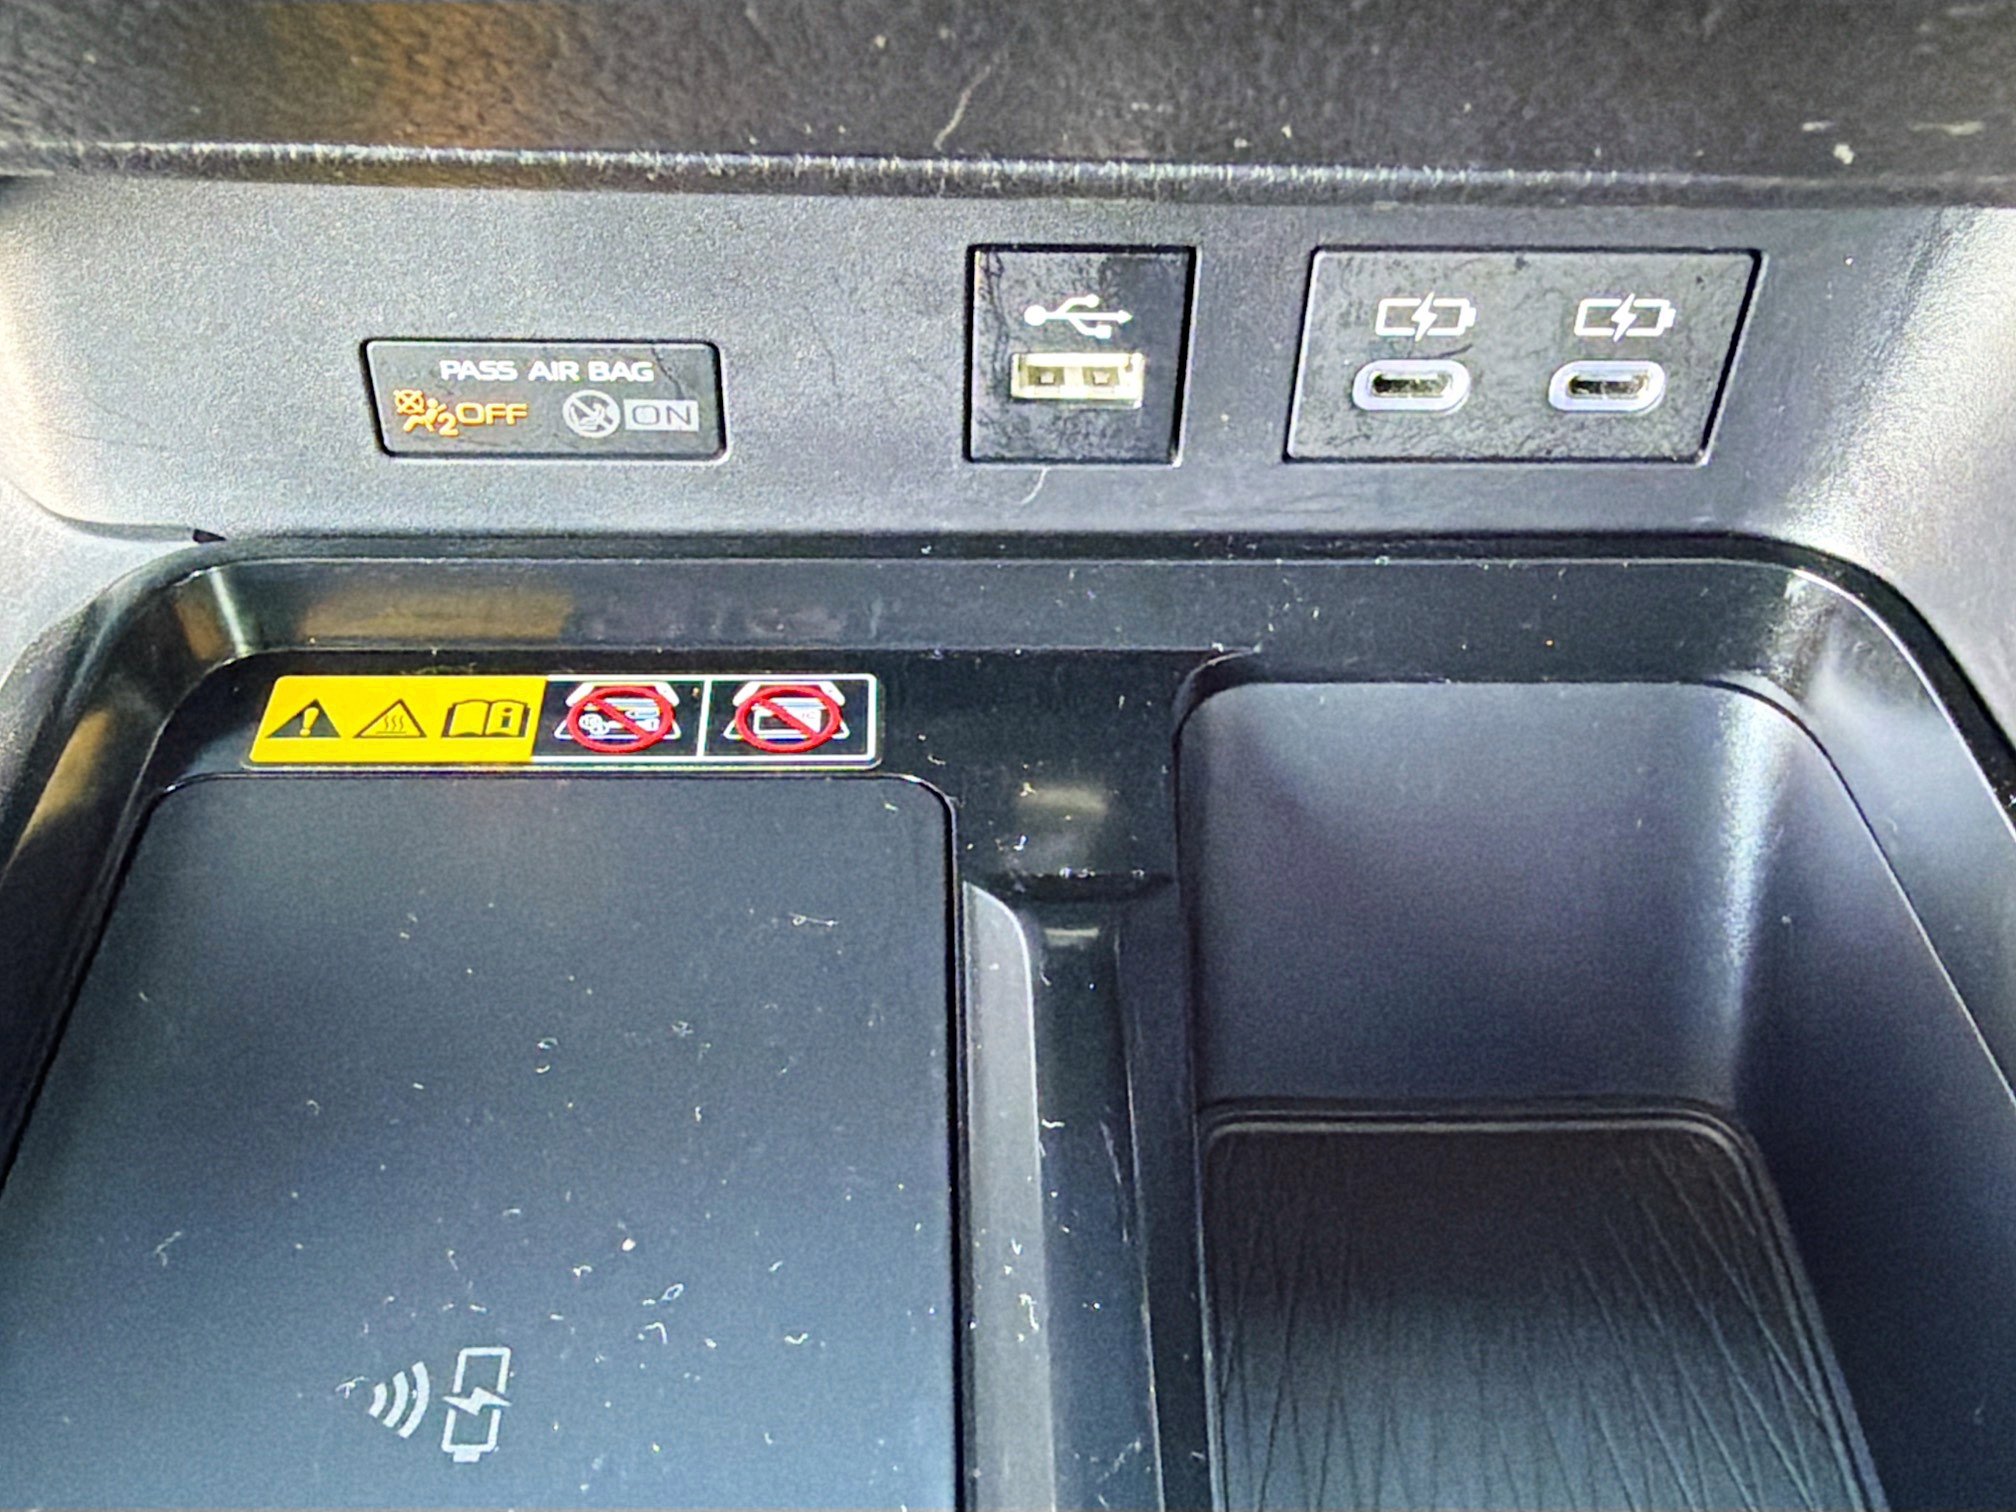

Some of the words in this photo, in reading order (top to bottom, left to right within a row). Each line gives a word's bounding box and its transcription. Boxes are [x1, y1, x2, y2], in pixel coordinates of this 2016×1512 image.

[439, 360, 518, 381] PASS
[527, 360, 580, 382] AIR
[587, 361, 655, 382] BAG
[455, 402, 528, 427] OFF
[632, 404, 691, 426] ON
